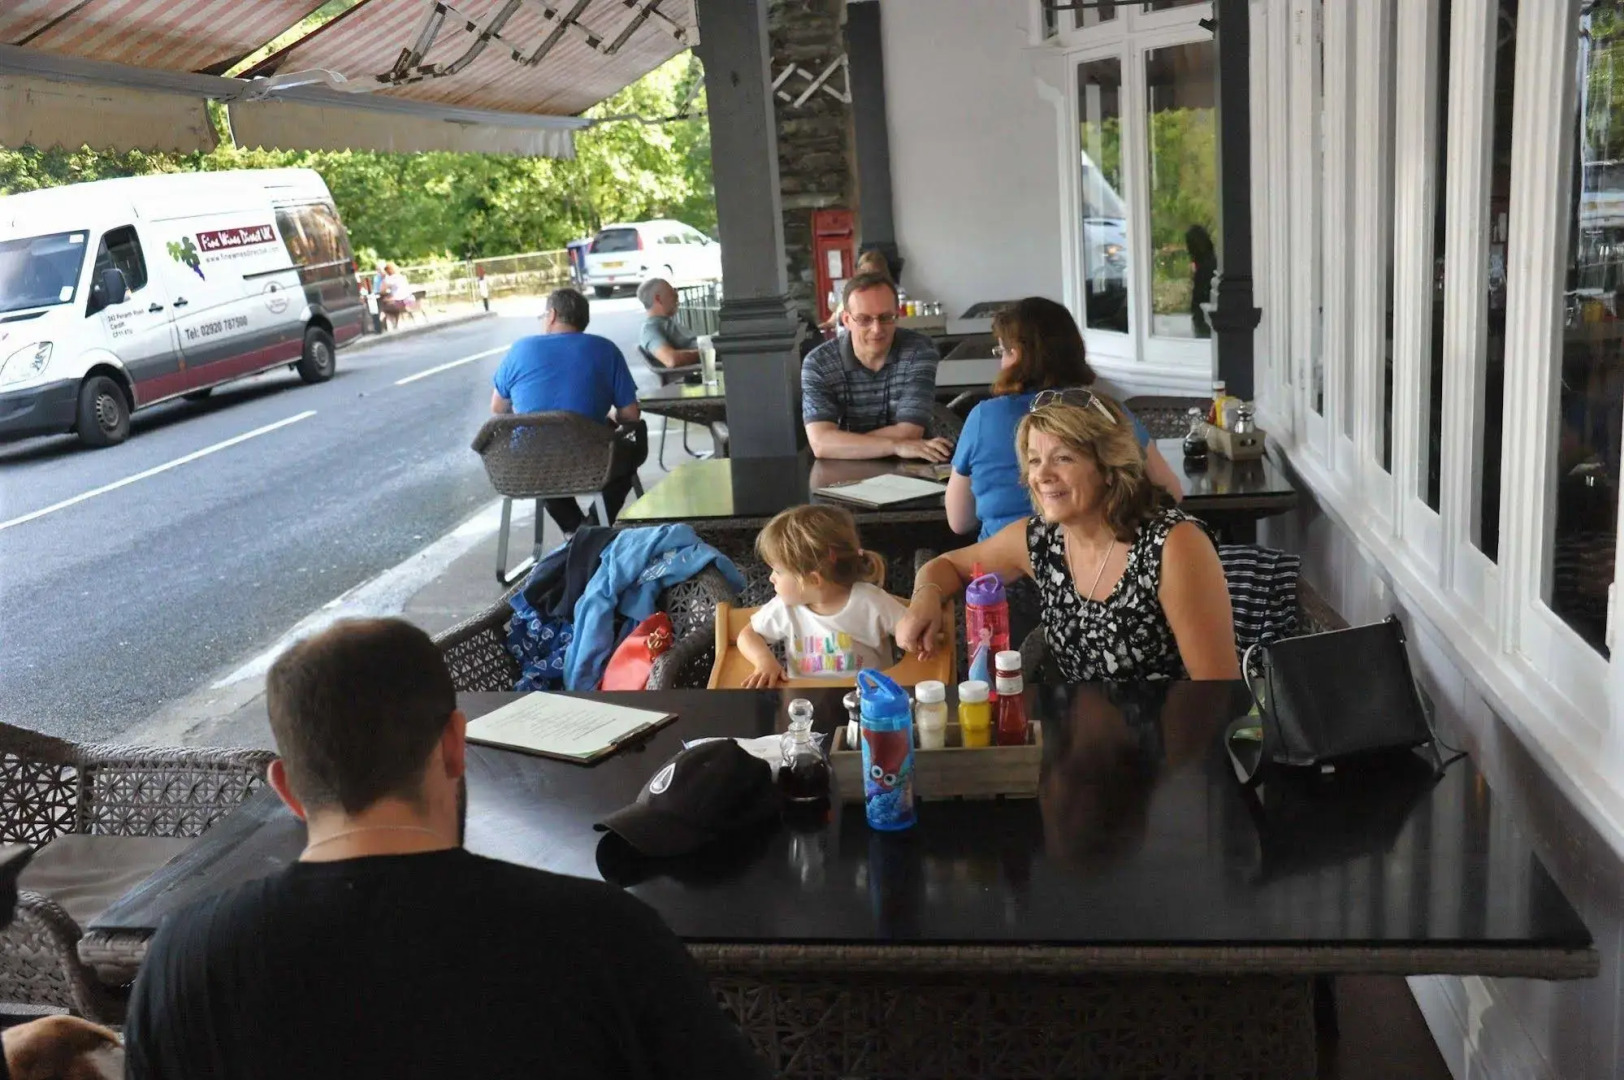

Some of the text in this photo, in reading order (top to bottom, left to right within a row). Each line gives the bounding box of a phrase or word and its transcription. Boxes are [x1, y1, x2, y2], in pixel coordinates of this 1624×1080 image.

[200, 226, 273, 250] Fine Wines Direct UK
[185, 326, 200, 340] Tel:
[200, 321, 222, 337] 02920
